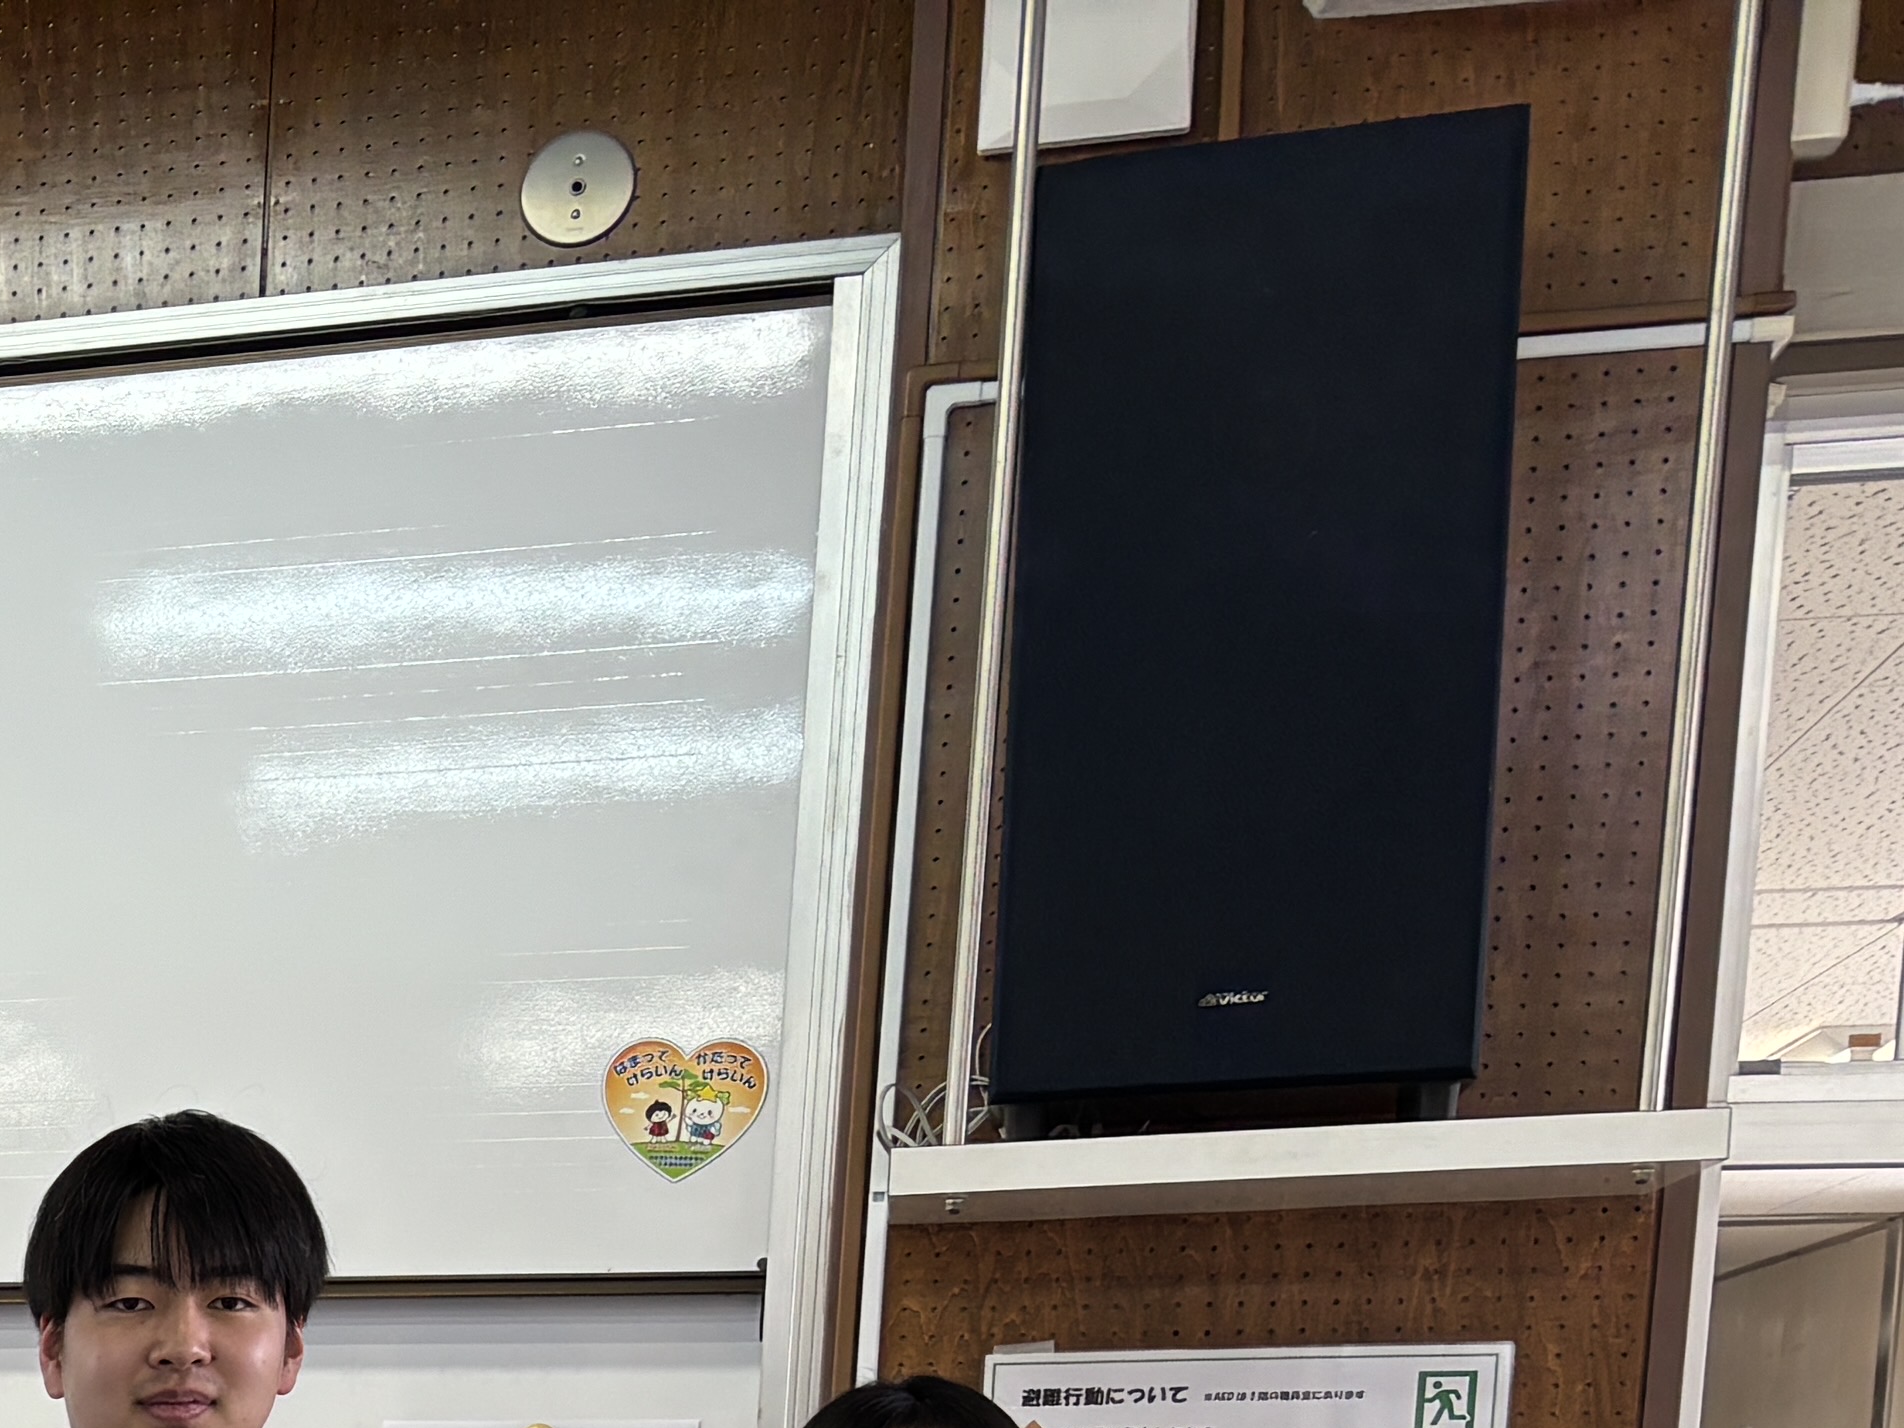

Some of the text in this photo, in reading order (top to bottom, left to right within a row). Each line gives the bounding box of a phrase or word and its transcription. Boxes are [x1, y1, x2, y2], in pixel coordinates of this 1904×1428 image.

[1021, 1386, 1189, 1407] 避難行動について
